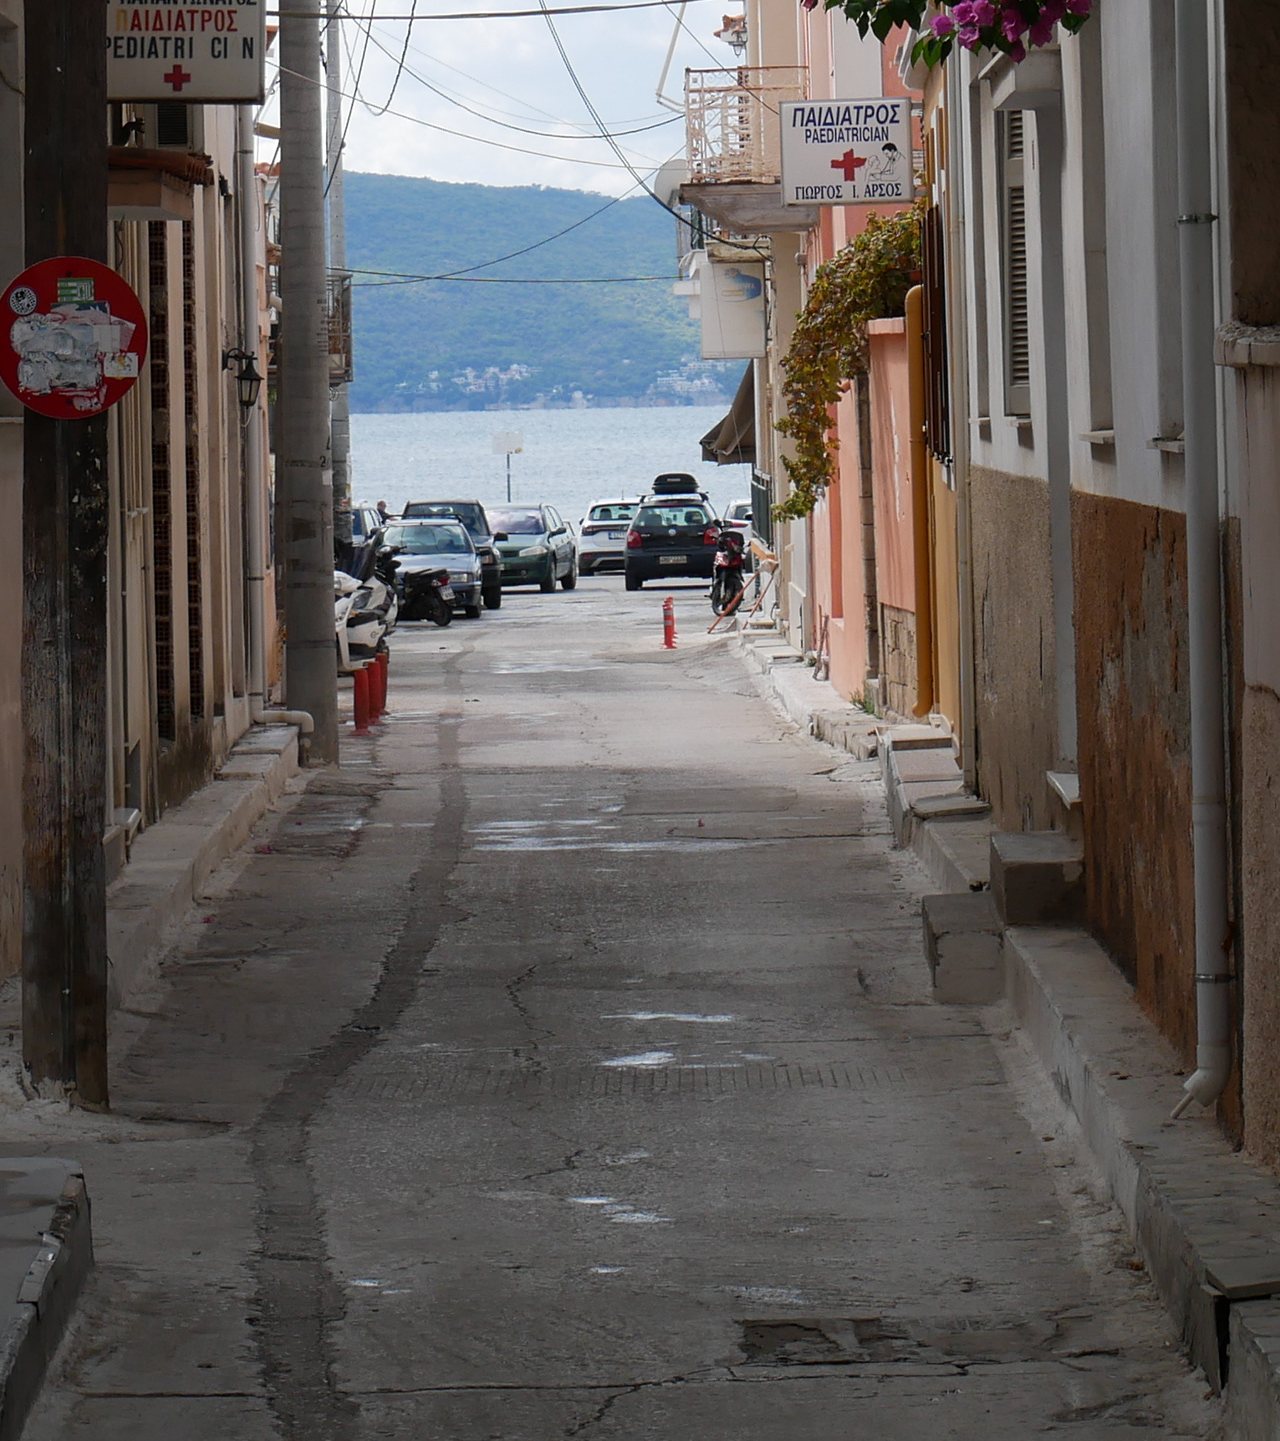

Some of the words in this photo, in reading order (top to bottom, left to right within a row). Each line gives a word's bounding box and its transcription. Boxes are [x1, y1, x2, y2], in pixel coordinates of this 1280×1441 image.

[116, 9, 238, 31] ΠΑΙΔΙΑΤΡΟΣ
[792, 104, 900, 127] ΠΑΙΔΙΑΤΡΟΣ
[805, 126, 889, 143] PAEDIATRICIAN
[795, 185, 843, 200] ΓΙΩΡΓΟΣ
[864, 183, 902, 198] ΑΡΣΟΣ
